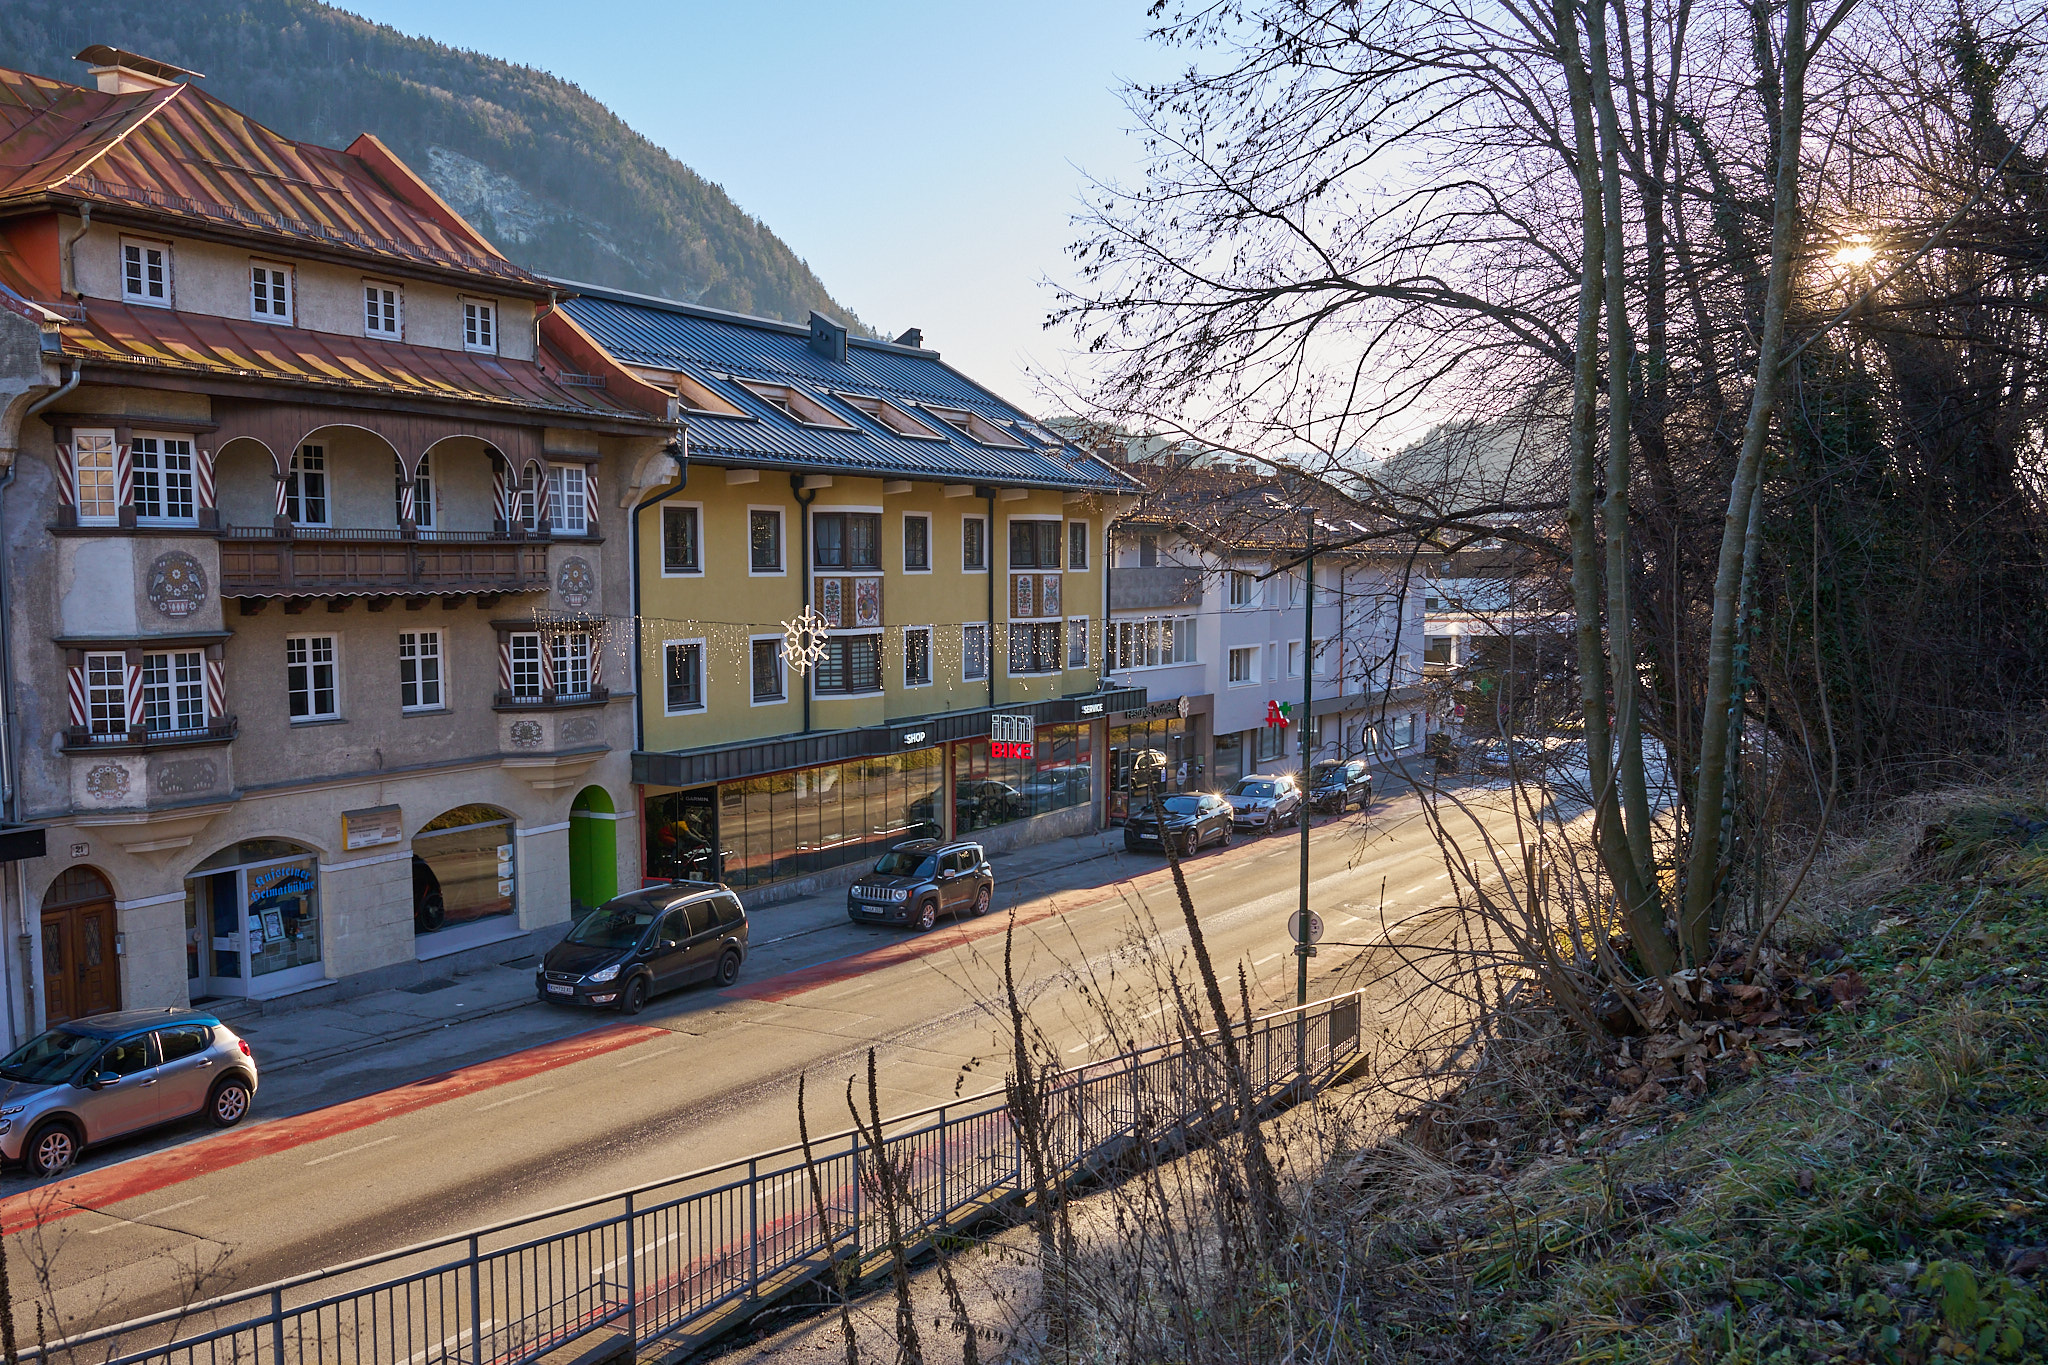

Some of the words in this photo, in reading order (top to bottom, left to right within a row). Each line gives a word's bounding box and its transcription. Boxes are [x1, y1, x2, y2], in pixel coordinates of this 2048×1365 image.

[1081, 703, 1104, 714] SERVICE
[991, 714, 1031, 742] inn
[904, 731, 926, 744] SHOP
[991, 742, 1032, 759] BIKE
[75, 845, 84, 853] 21
[255, 865, 311, 888] Kufsteiner
[250, 880, 315, 902] Heimatbühne
